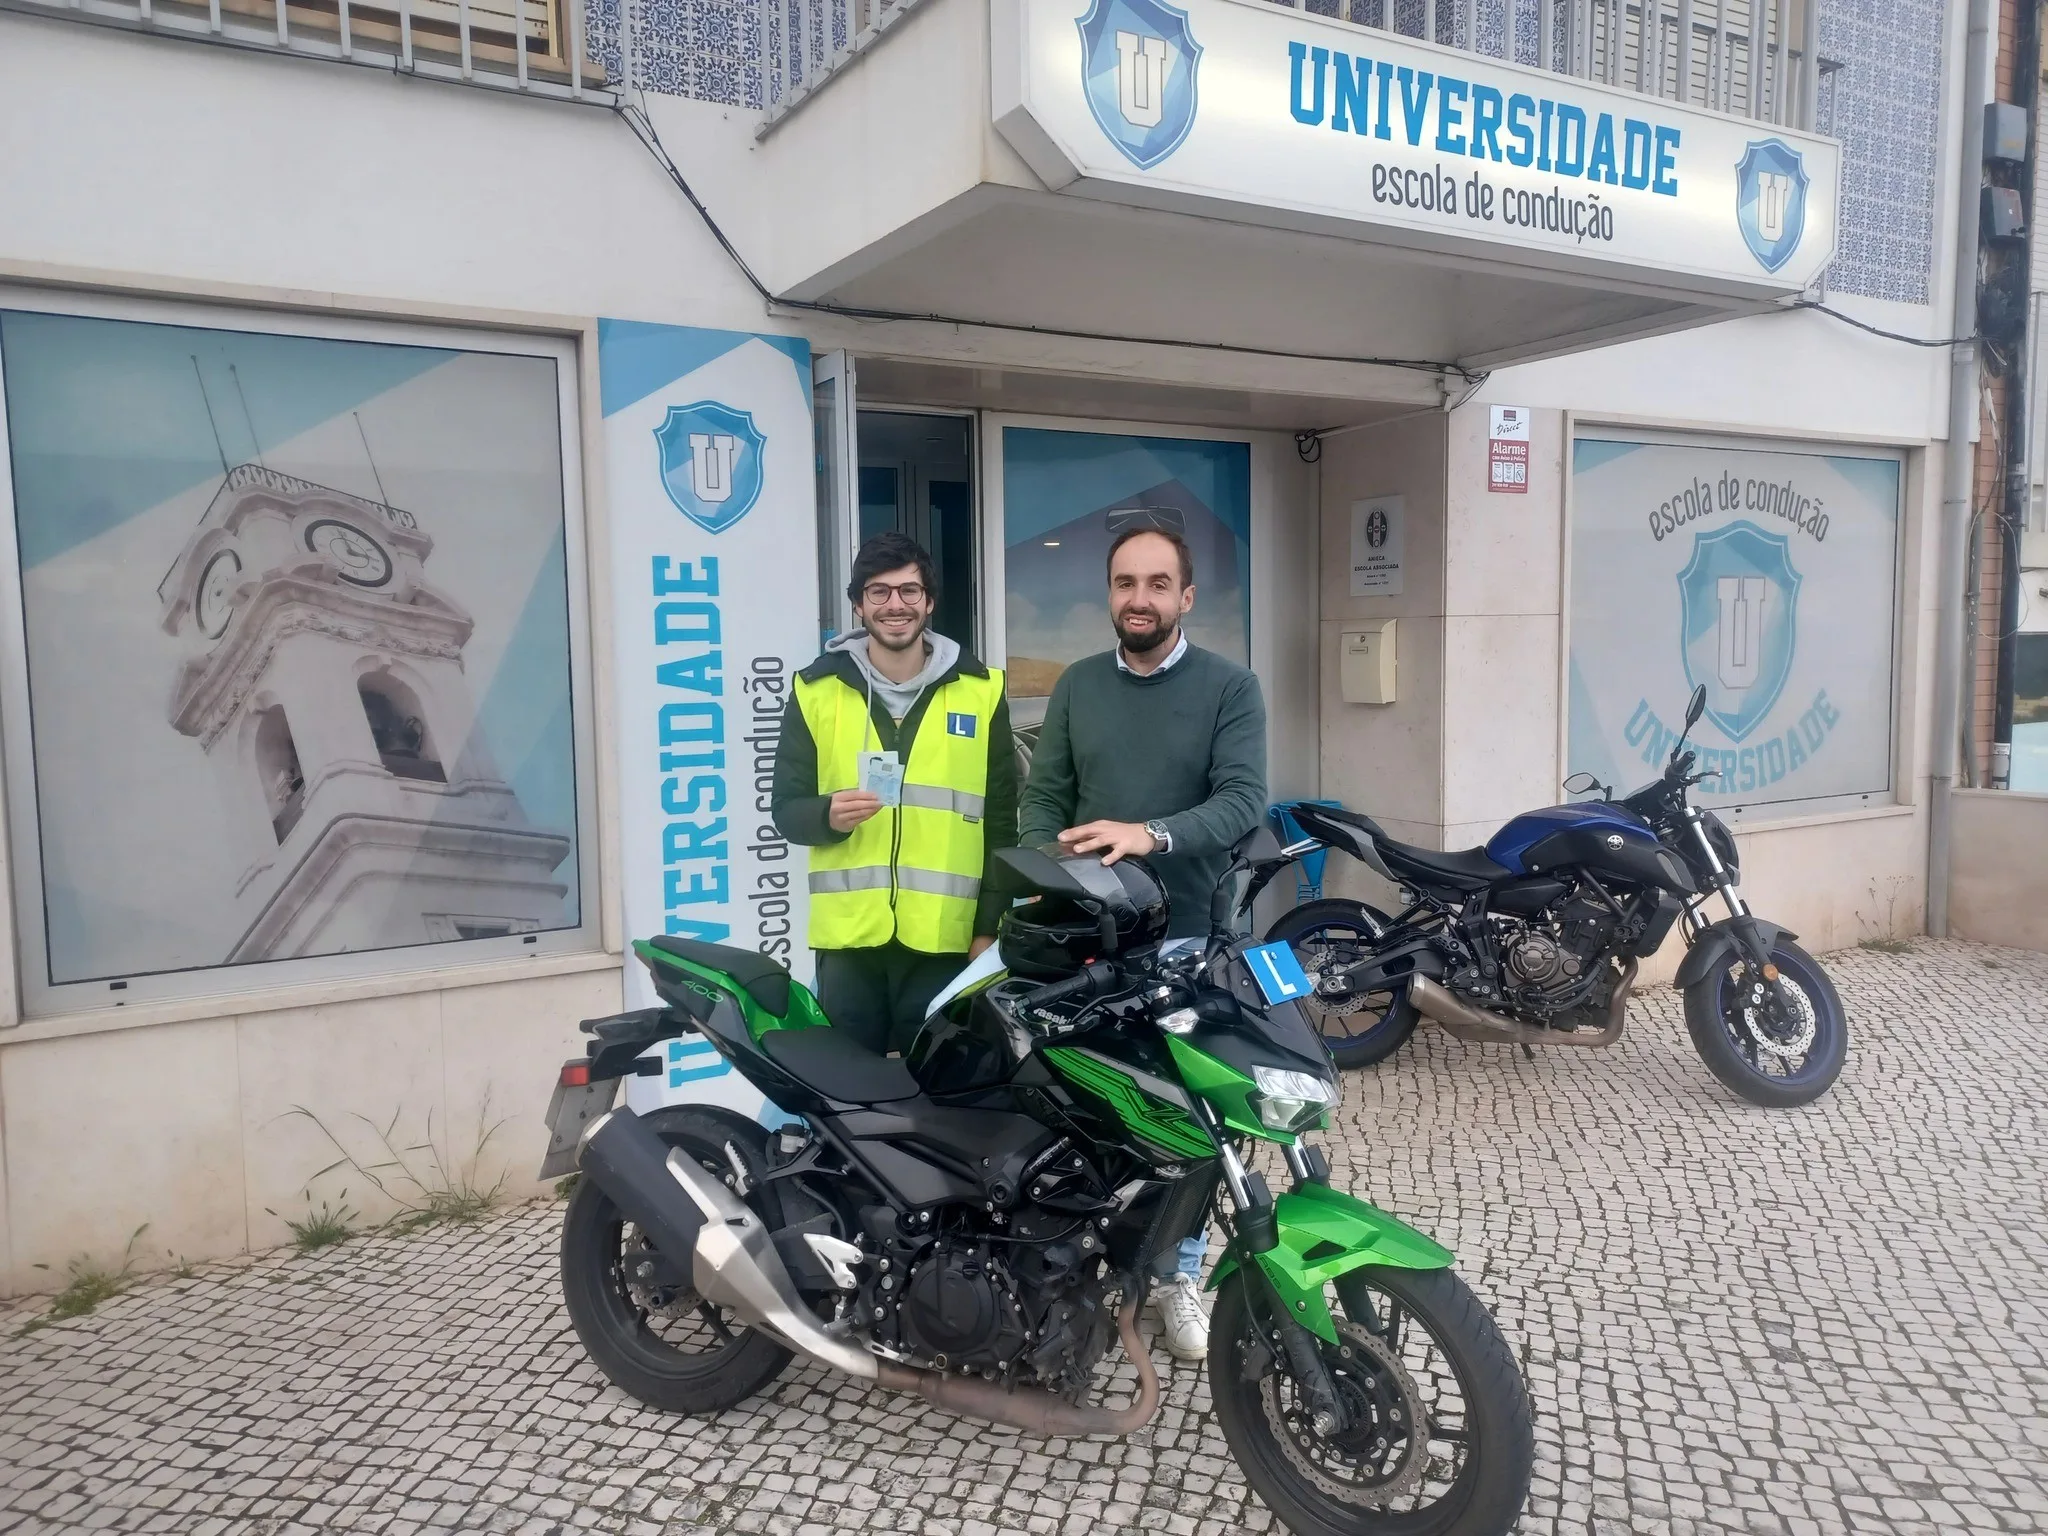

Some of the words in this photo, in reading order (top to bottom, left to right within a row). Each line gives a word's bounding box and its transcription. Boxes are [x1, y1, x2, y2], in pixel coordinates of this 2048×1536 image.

[1288, 41, 1681, 197] UNIVERSIDADE
[1371, 163, 1456, 215] escola
[1465, 170, 1494, 221] de
[1503, 185, 1613, 244] condução
[1492, 442, 1526, 455] Alarme
[1649, 476, 1713, 542] escola
[1717, 469, 1740, 511] de
[1745, 479, 1830, 542] condução
[955, 714, 966, 735] L
[681, 980, 724, 1003] 400
[1260, 949, 1298, 996] L
